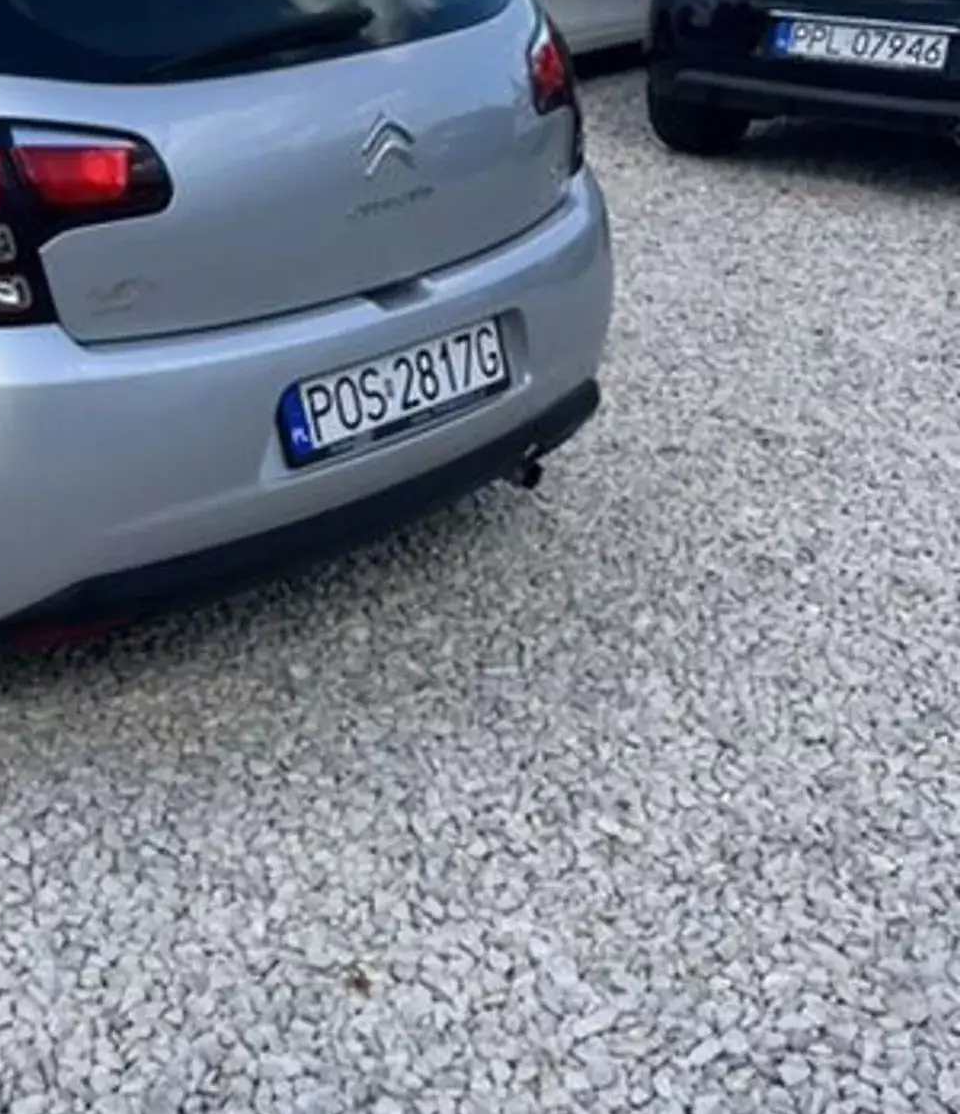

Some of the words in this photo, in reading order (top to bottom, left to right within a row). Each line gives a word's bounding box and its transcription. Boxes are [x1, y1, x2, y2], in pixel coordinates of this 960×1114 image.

[794, 24, 840, 54] PPL
[852, 29, 940, 64] 07946
[306, 368, 386, 442] POS
[392, 327, 500, 411] 2817G
